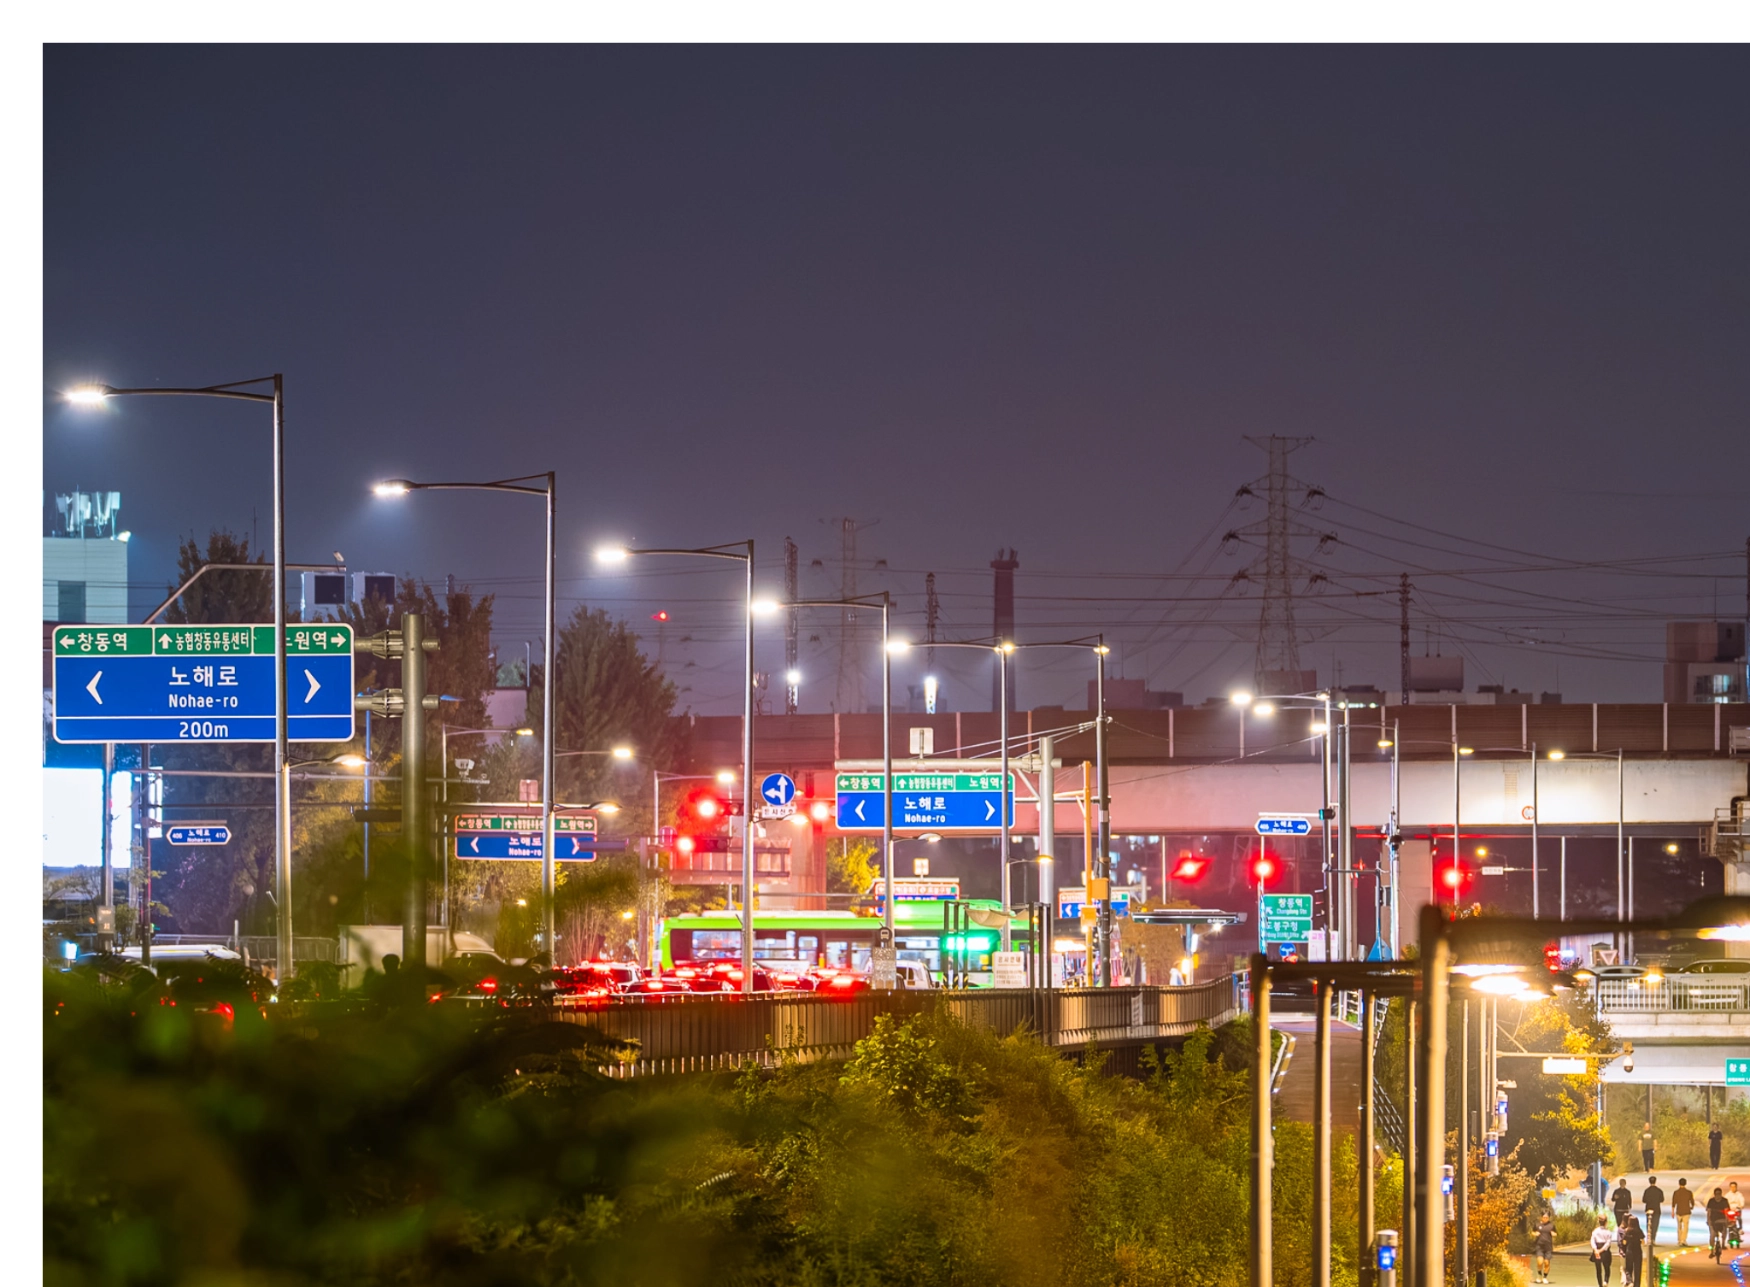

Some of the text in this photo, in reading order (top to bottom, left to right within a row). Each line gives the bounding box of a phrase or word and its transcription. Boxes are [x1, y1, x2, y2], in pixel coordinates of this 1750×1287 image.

[77, 632, 128, 652] 창동역
[175, 631, 249, 652] 농협창동유통센터
[168, 665, 239, 688] 노해로
[168, 693, 239, 709] Nohae-ro
[179, 721, 229, 738] 200m
[850, 777, 881, 790] 창동역
[969, 777, 1000, 789] 노원역
[904, 797, 946, 811] 노해로
[904, 813, 946, 824] Nohae-ro
[560, 820, 585, 831] 노원역
[508, 836, 543, 847] 노해로
[508, 847, 542, 857] Nohae-ro
